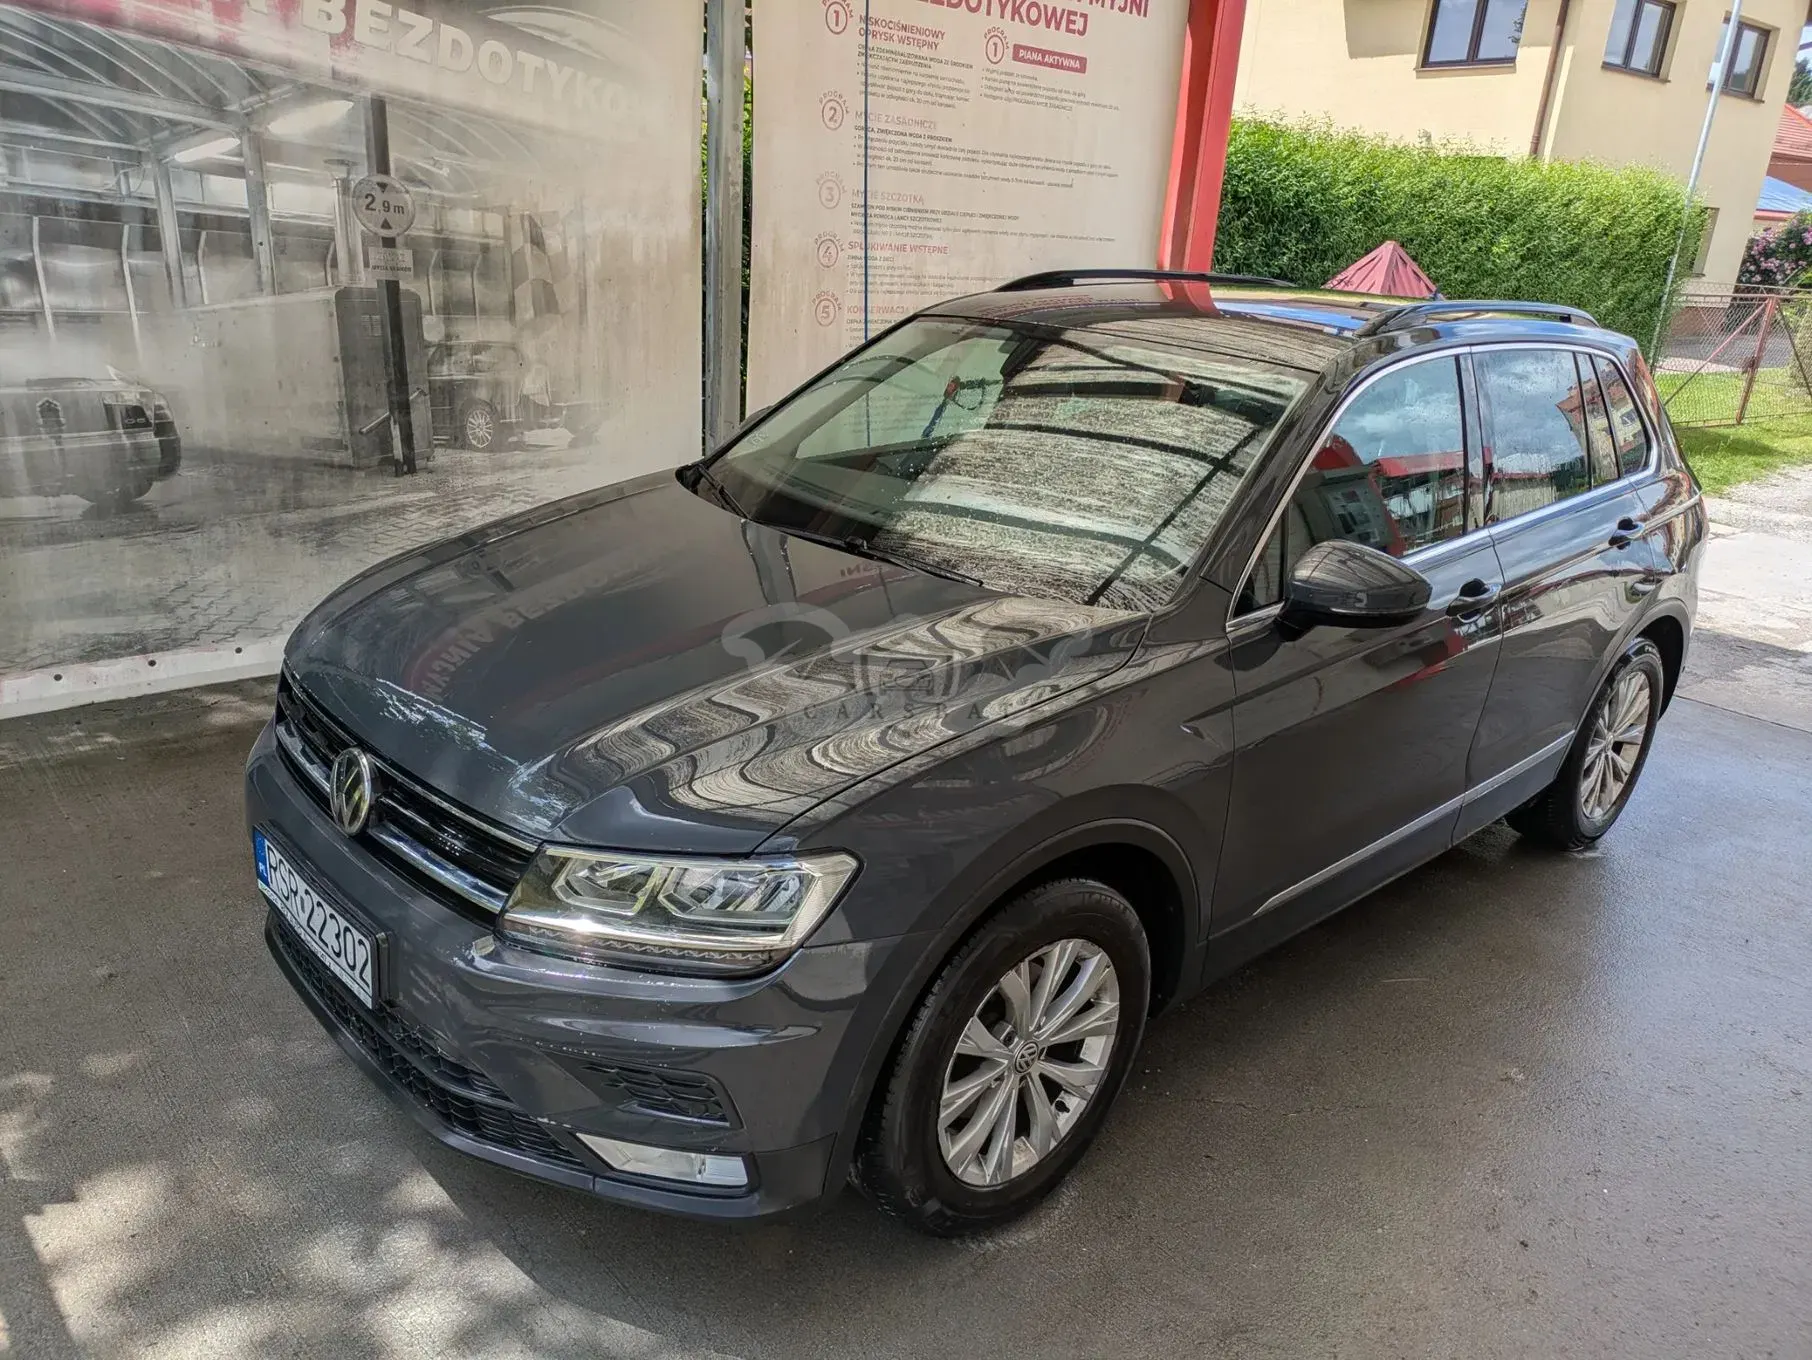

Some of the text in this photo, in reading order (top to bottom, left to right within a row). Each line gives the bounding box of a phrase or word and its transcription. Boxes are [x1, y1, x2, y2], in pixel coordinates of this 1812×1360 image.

[833, 9, 840, 27] 1
[859, 14, 946, 40] NSKOCIŚNIENIOWY
[897, 35, 941, 51] WSTĘPNY
[983, 26, 1009, 50] PROGRAM
[992, 42, 998, 57] 1
[1019, 49, 1081, 69] PIANA AKTYWNA
[828, 105, 837, 123] 2
[825, 186, 834, 202] 3
[393, 204, 405, 215] m
[848, 241, 949, 255] SPŁKIWANIE WSTĘPNE
[819, 304, 830, 319] 5
[267, 844, 371, 989] RSR 22302
